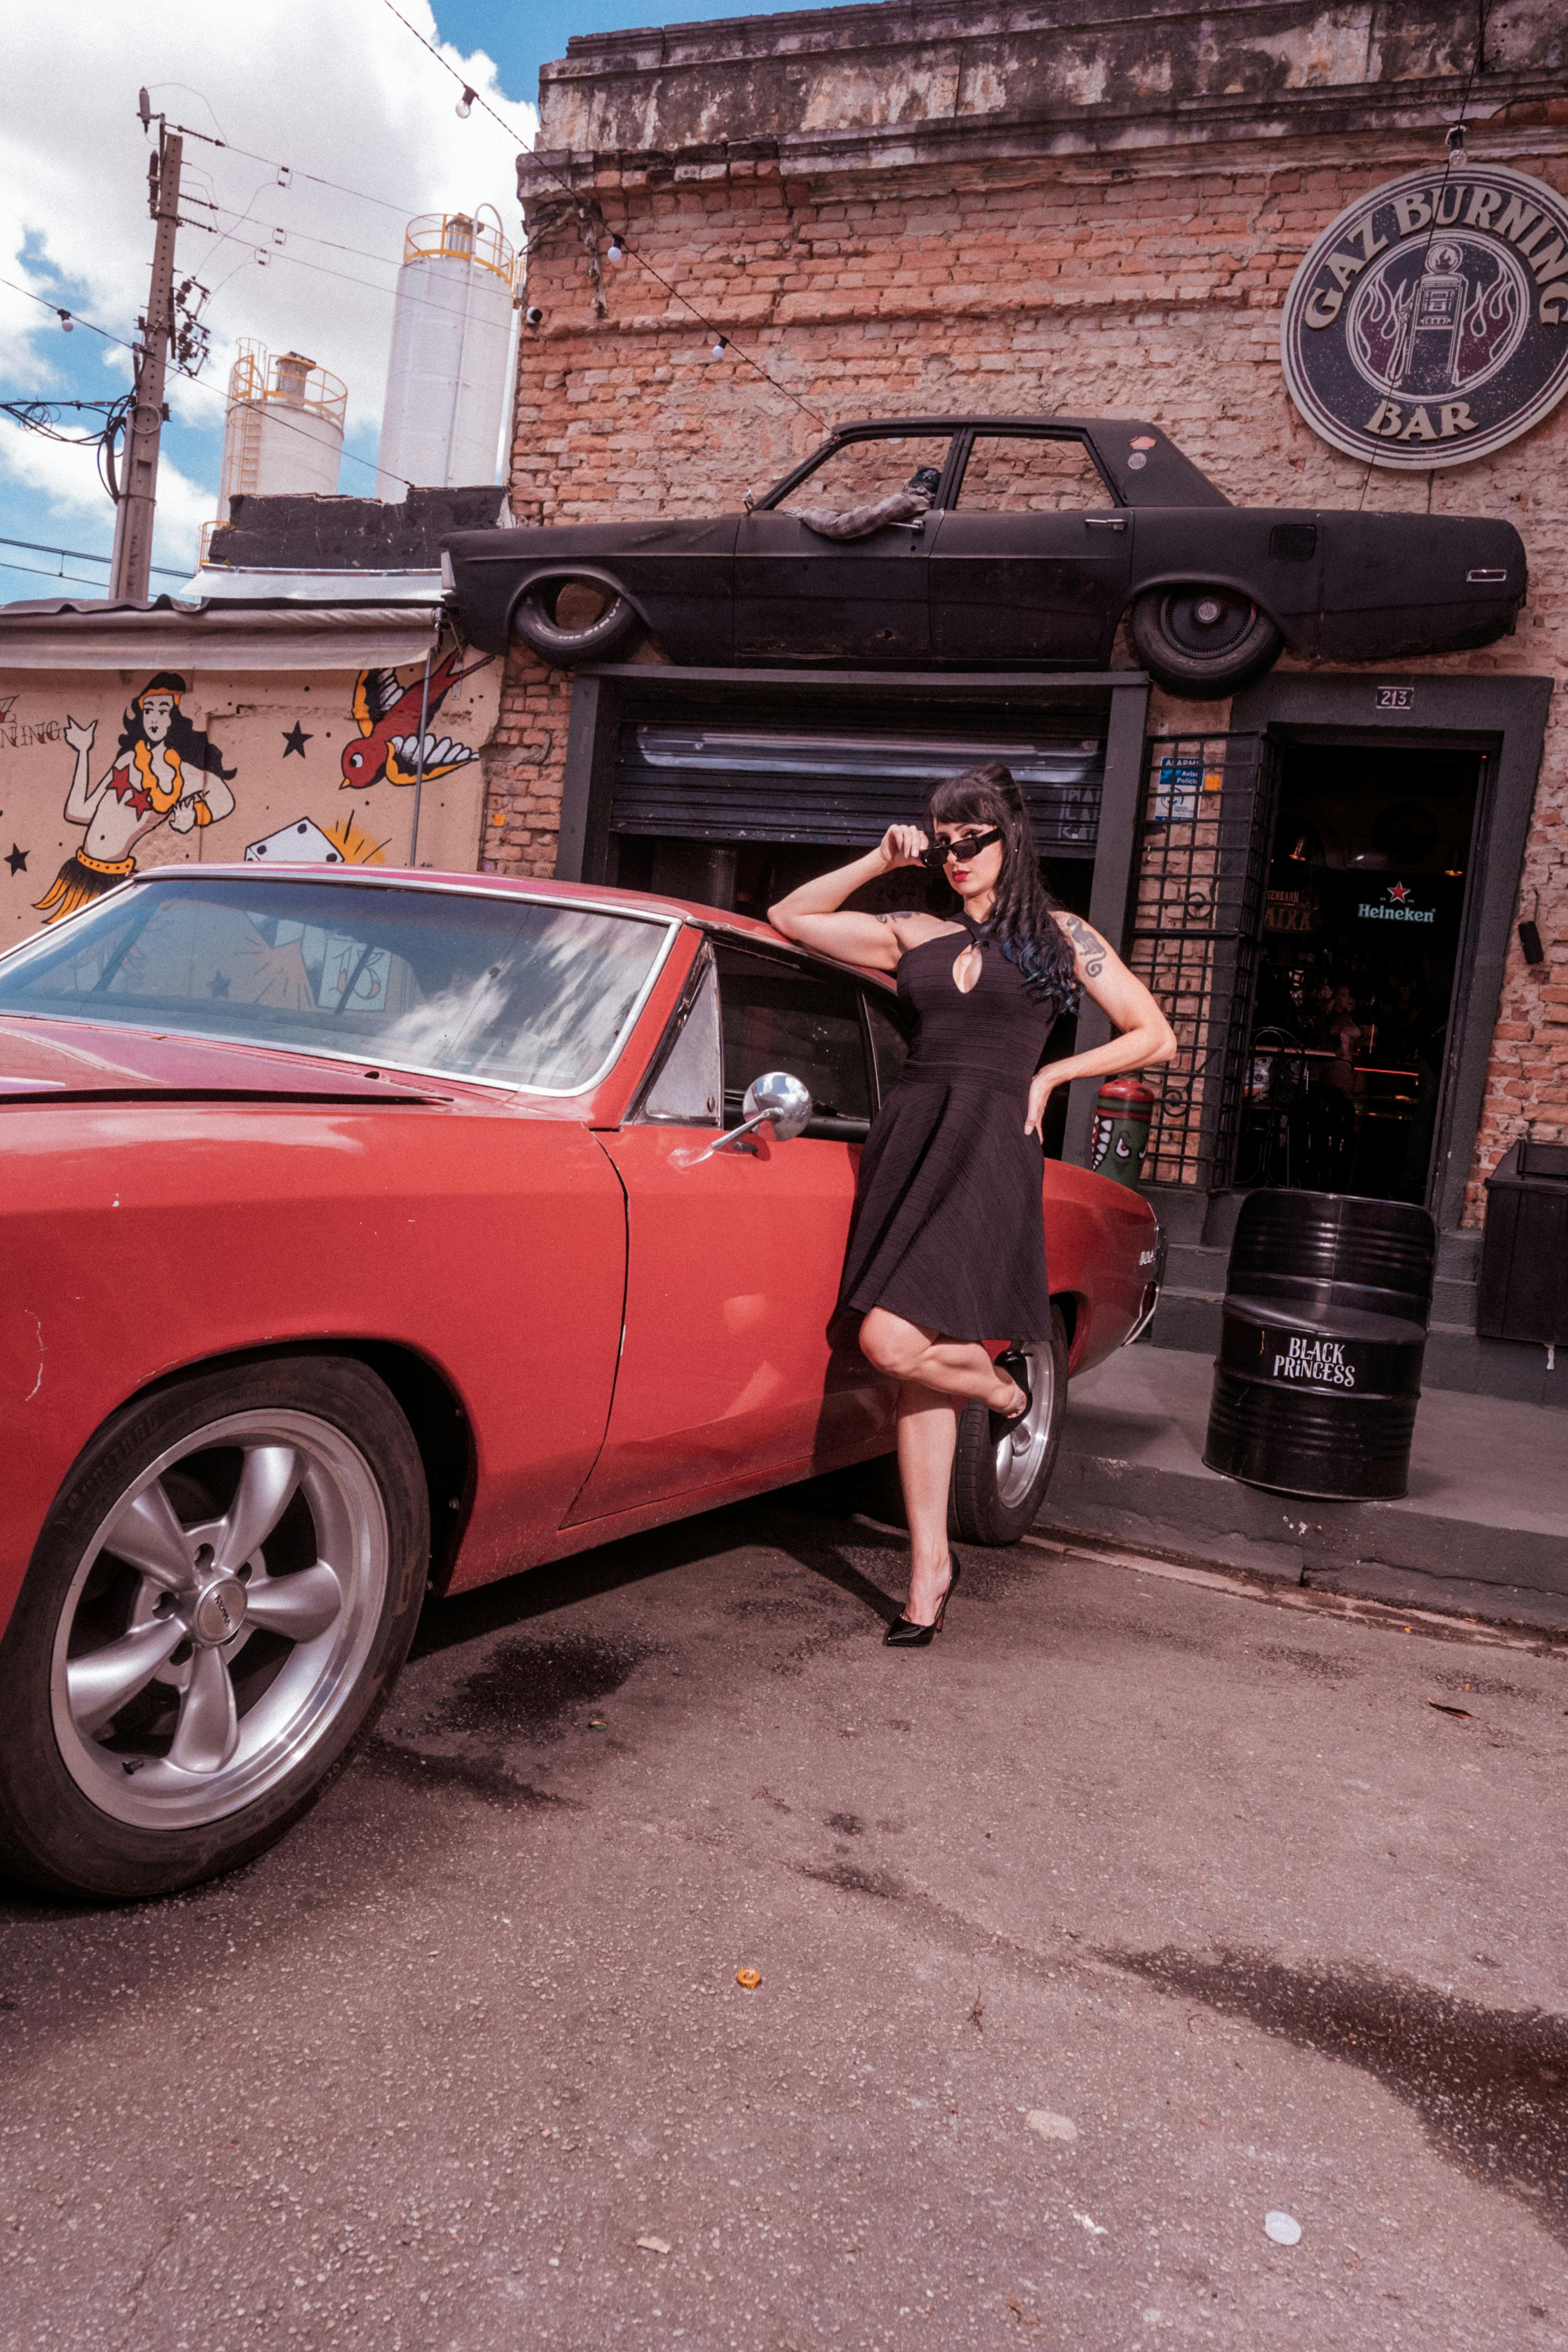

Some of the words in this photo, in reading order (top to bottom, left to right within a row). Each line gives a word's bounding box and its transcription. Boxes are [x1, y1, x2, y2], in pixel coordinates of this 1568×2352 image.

[1305, 213, 1389, 330] GAZ
[1391, 186, 1568, 326] BURNING
[1363, 399, 1480, 442] BAR
[1381, 690, 1407, 705] 213
[1358, 903, 1434, 923] Heineken
[1289, 1337, 1345, 1365] BLACK
